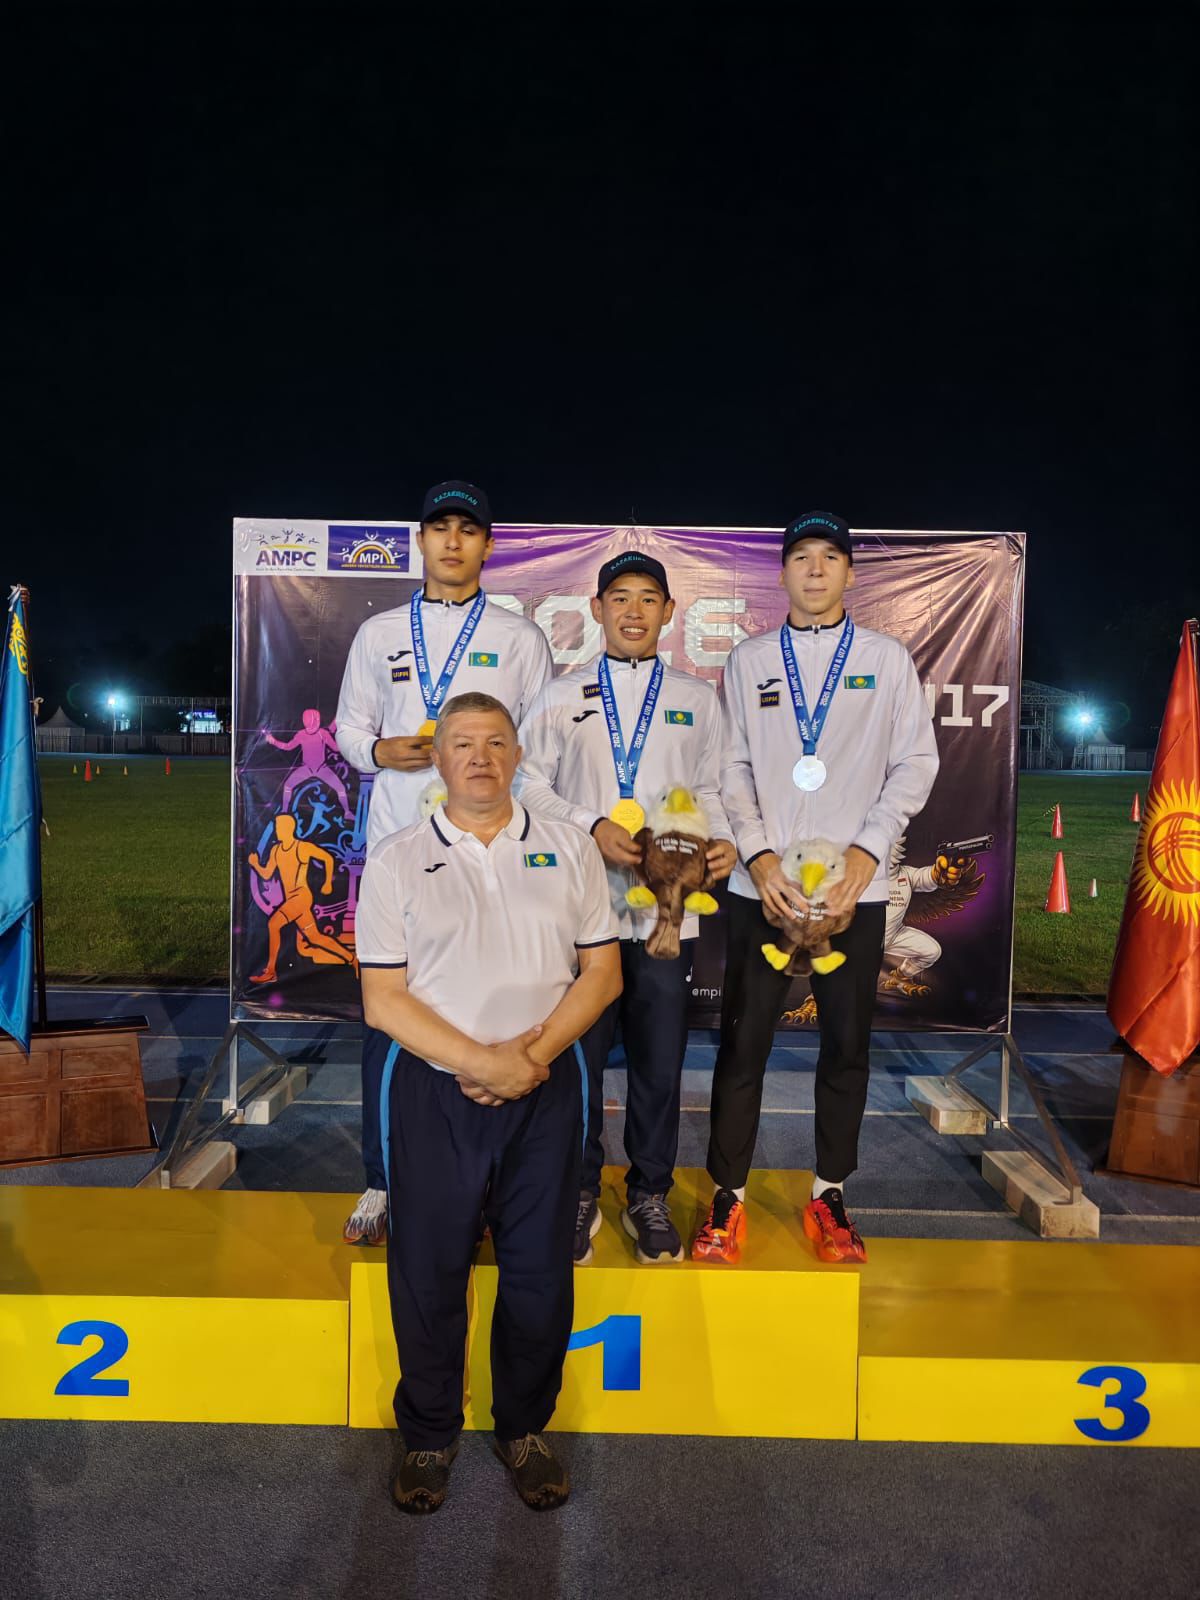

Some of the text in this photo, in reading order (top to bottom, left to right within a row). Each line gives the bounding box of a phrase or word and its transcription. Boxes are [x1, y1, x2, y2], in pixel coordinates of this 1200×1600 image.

[793, 518, 839, 532] KAZAKHSTAN
[256, 550, 316, 566] AMPC
[360, 553, 383, 564] MPI
[432, 685, 444, 706] AMPC
[800, 720, 810, 741] AMPC
[617, 761, 626, 783] AMPC
[54, 1320, 129, 1396] 2
[567, 1314, 641, 1391] 1
[1074, 1366, 1150, 1441] 3
